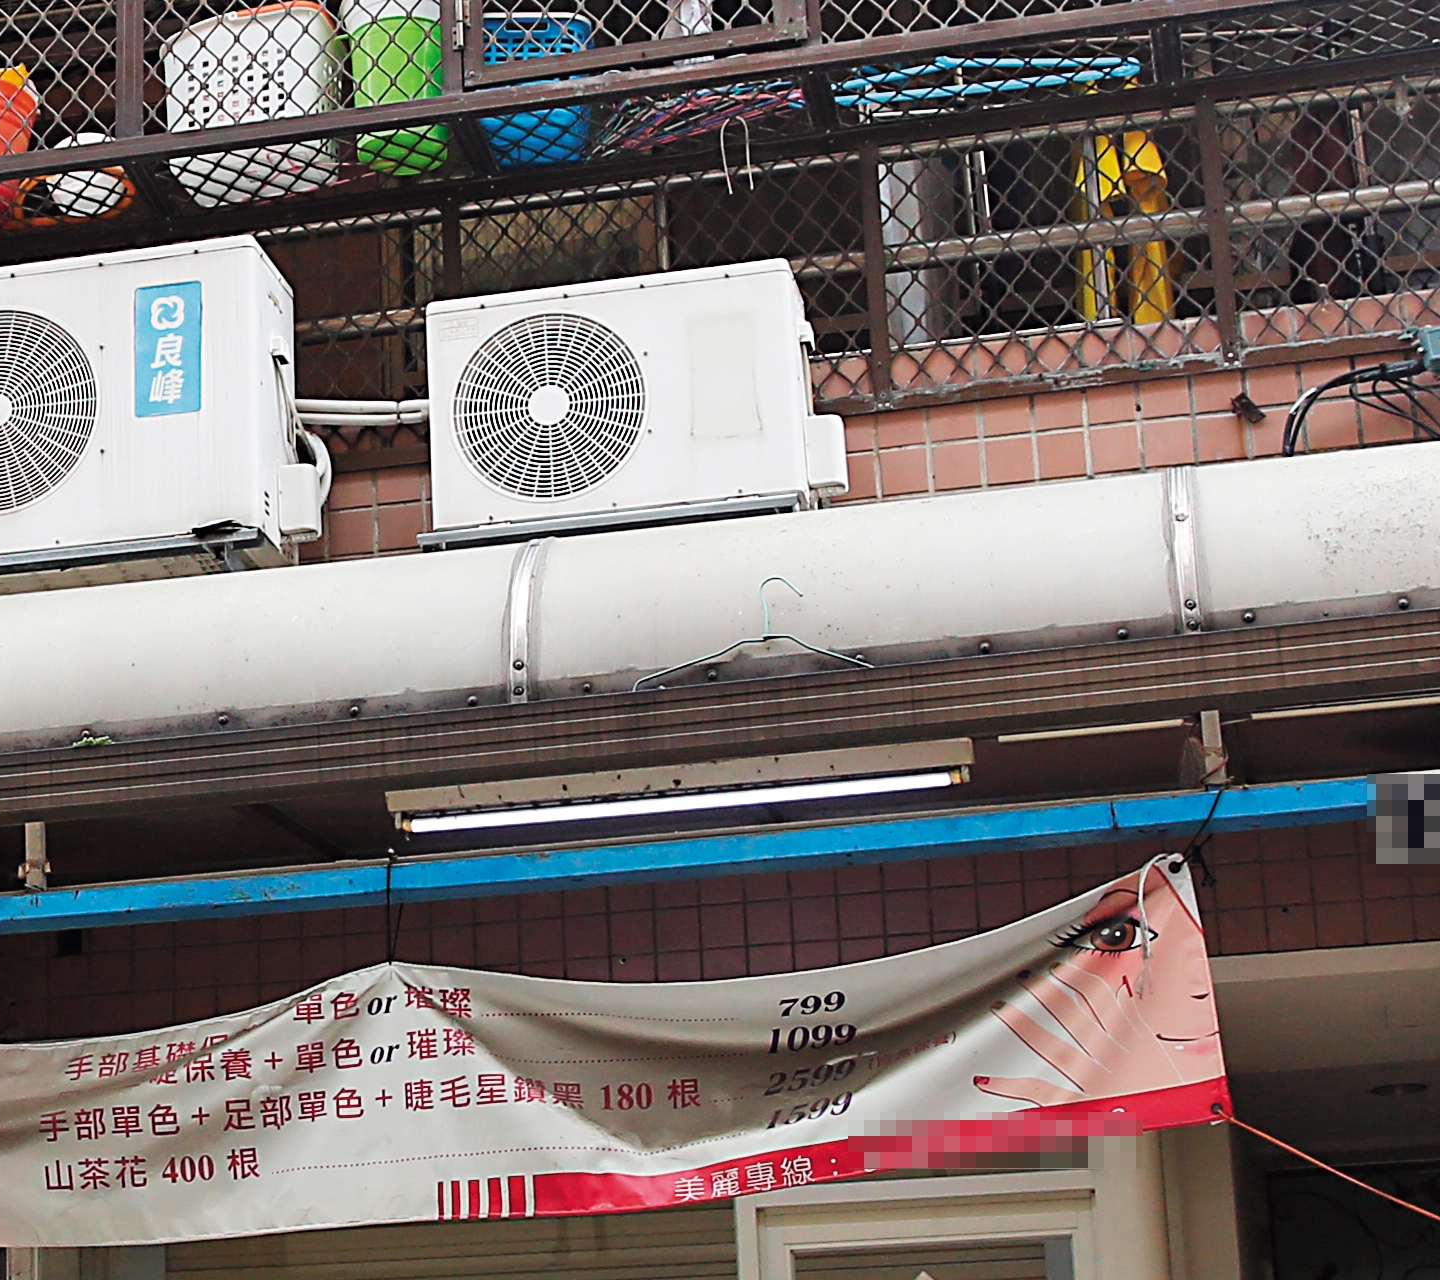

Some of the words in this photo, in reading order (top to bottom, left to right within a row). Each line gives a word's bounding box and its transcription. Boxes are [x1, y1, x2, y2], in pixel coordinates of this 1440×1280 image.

[149, 333, 184, 404] 良峰
[779, 991, 845, 1017] 799
[768, 1023, 857, 1054] 1099
[764, 1059, 856, 1096] 2599
[44, 1156, 147, 1192] 山茶花
[162, 1154, 214, 1184] 400
[227, 1148, 261, 1180] 根
[767, 1091, 853, 1130] 1599
